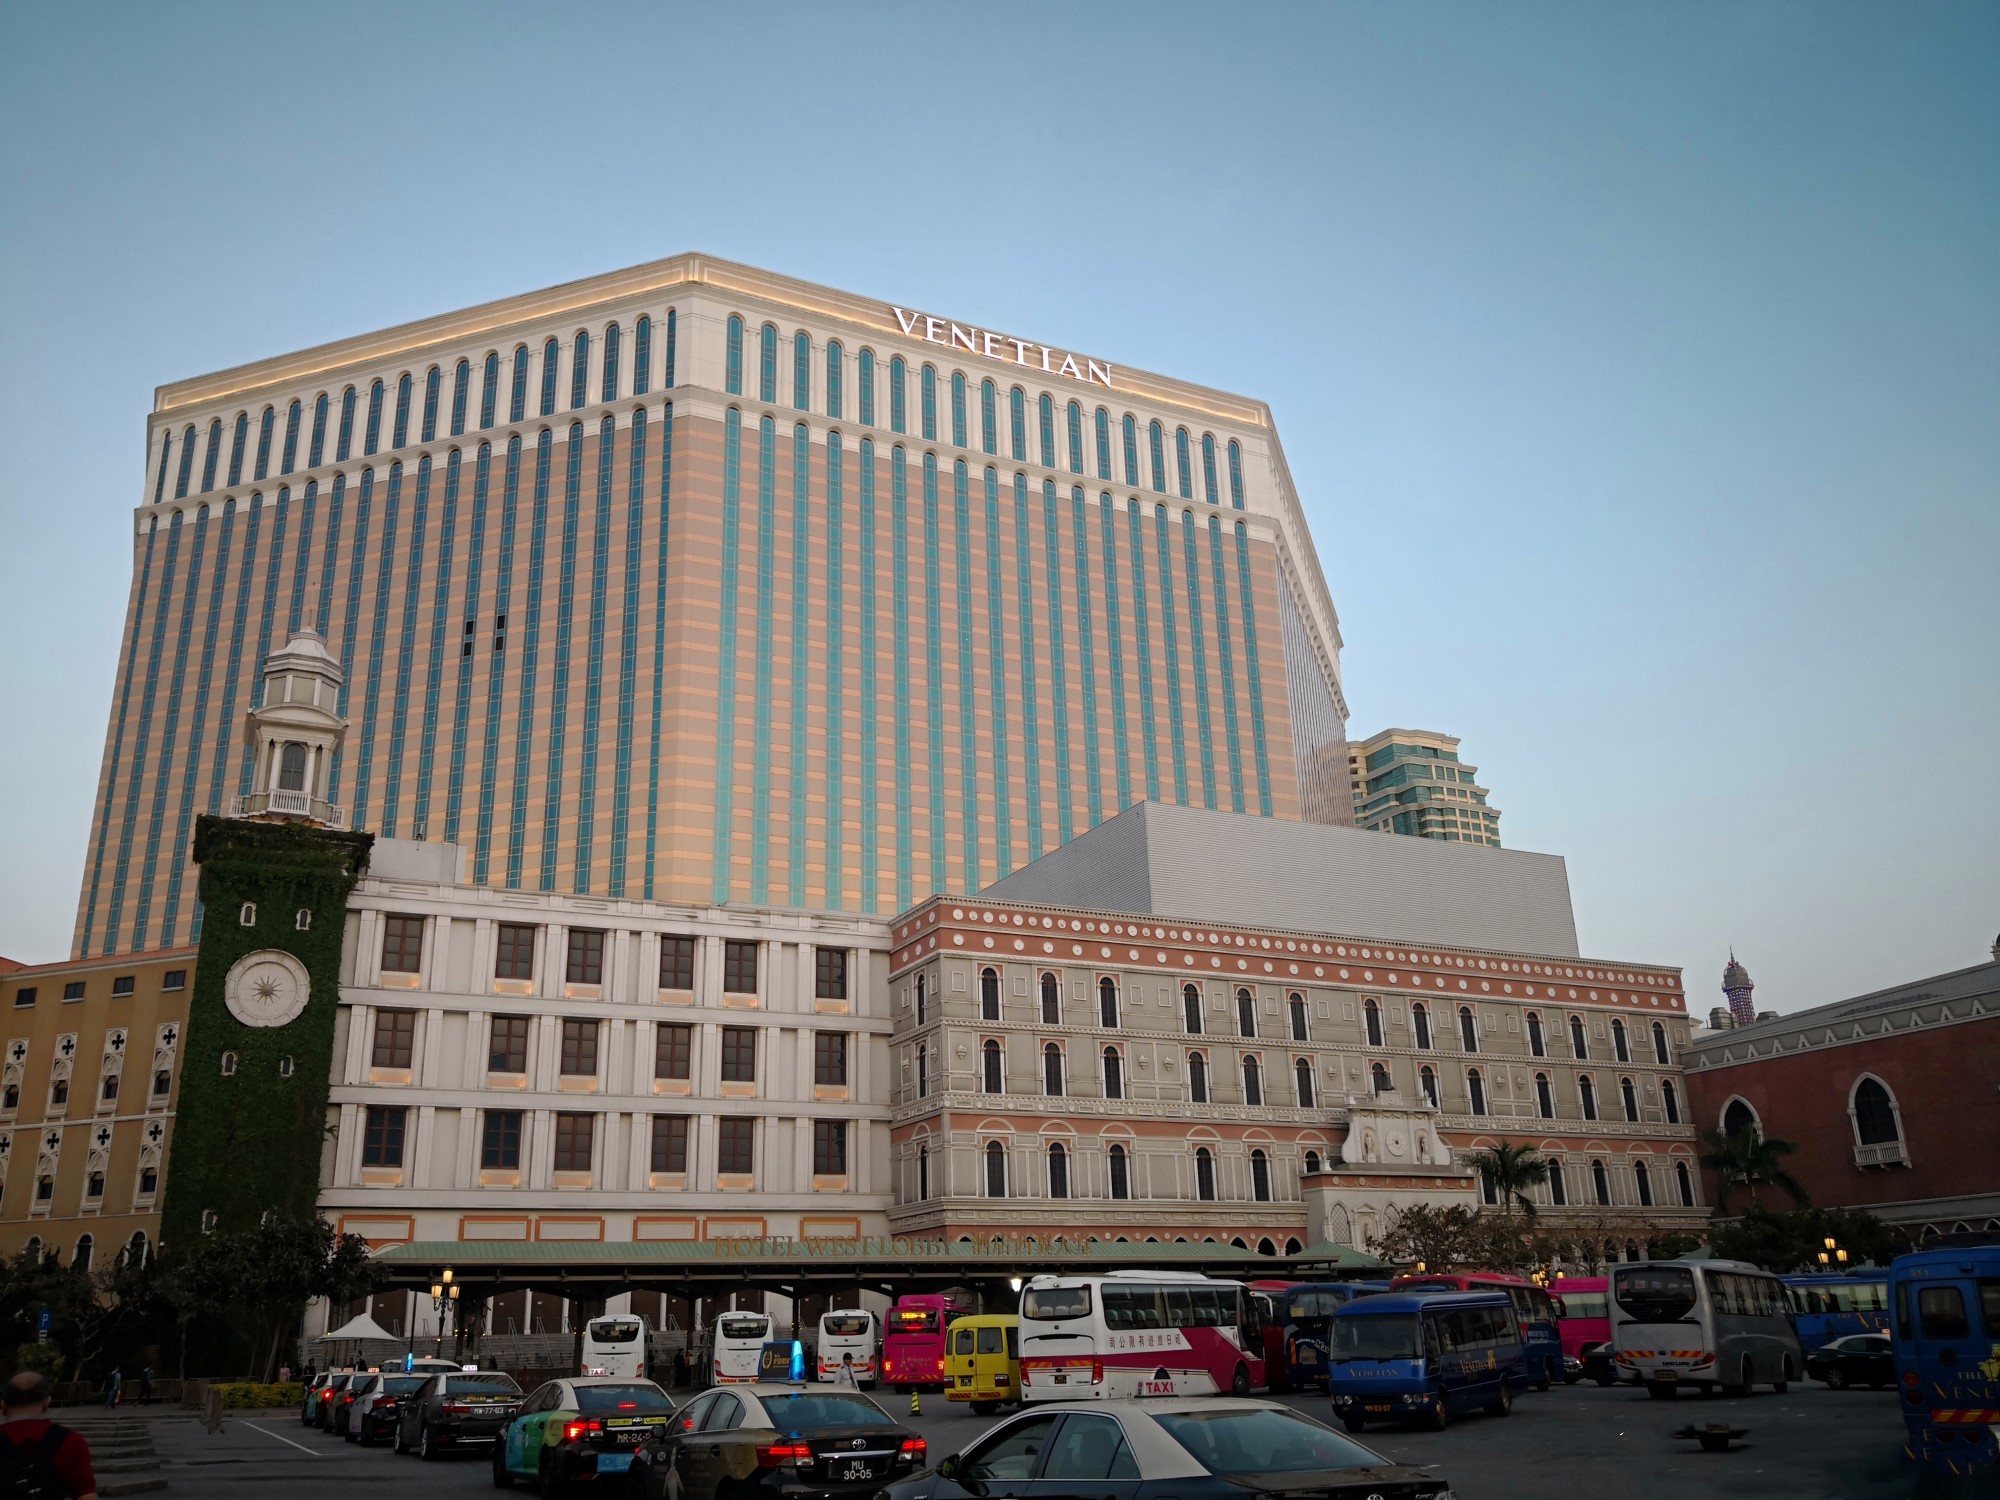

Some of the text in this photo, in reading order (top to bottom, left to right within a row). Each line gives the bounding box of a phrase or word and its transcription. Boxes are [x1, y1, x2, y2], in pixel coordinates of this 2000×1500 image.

[892, 306, 1112, 388] VENETIAN
[713, 1235, 952, 1256] HOTEL WEST LOBBY
[1146, 1382, 1174, 1393] TAXI
[851, 1460, 864, 1470] MU
[843, 1470, 873, 1480] 30-05
